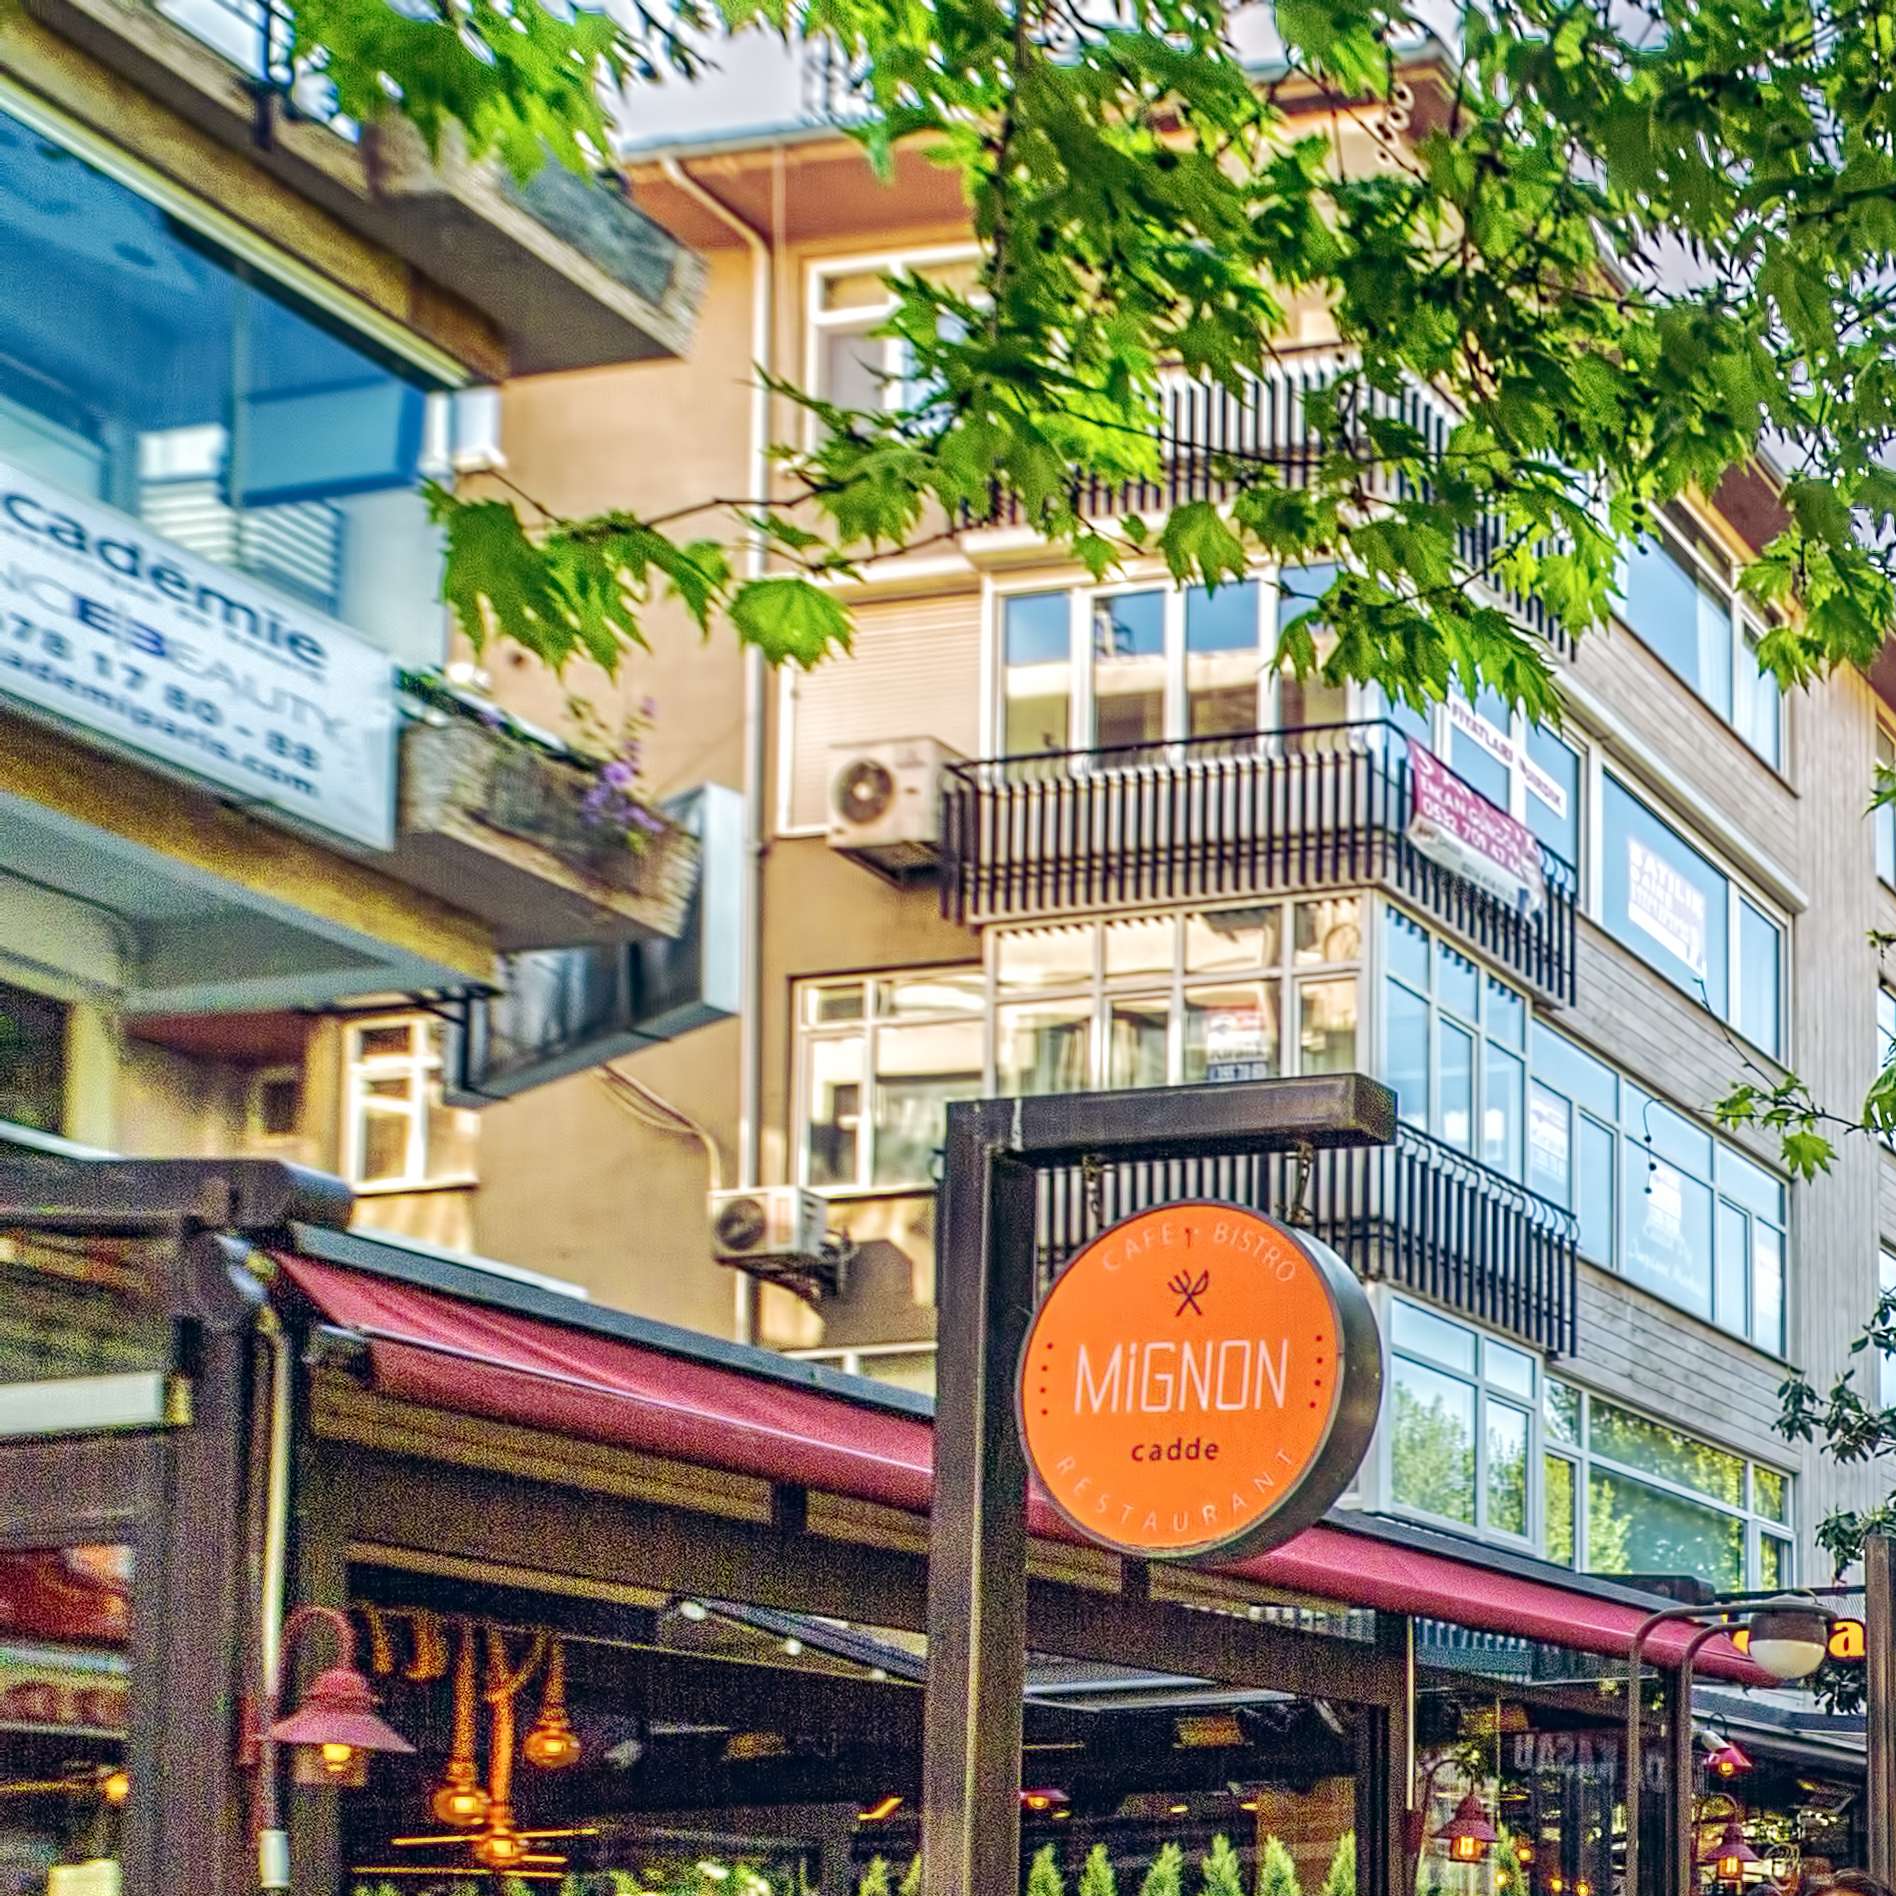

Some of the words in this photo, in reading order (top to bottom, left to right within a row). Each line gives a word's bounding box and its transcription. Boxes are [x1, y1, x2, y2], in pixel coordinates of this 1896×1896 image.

[0, 606, 73, 660] 78
[1102, 1220, 1175, 1273] CAFE
[1212, 1221, 1298, 1285] BISTRO
[1130, 1436, 1221, 1463] cadde
[1056, 1446, 1296, 1533] RESTAURANT
